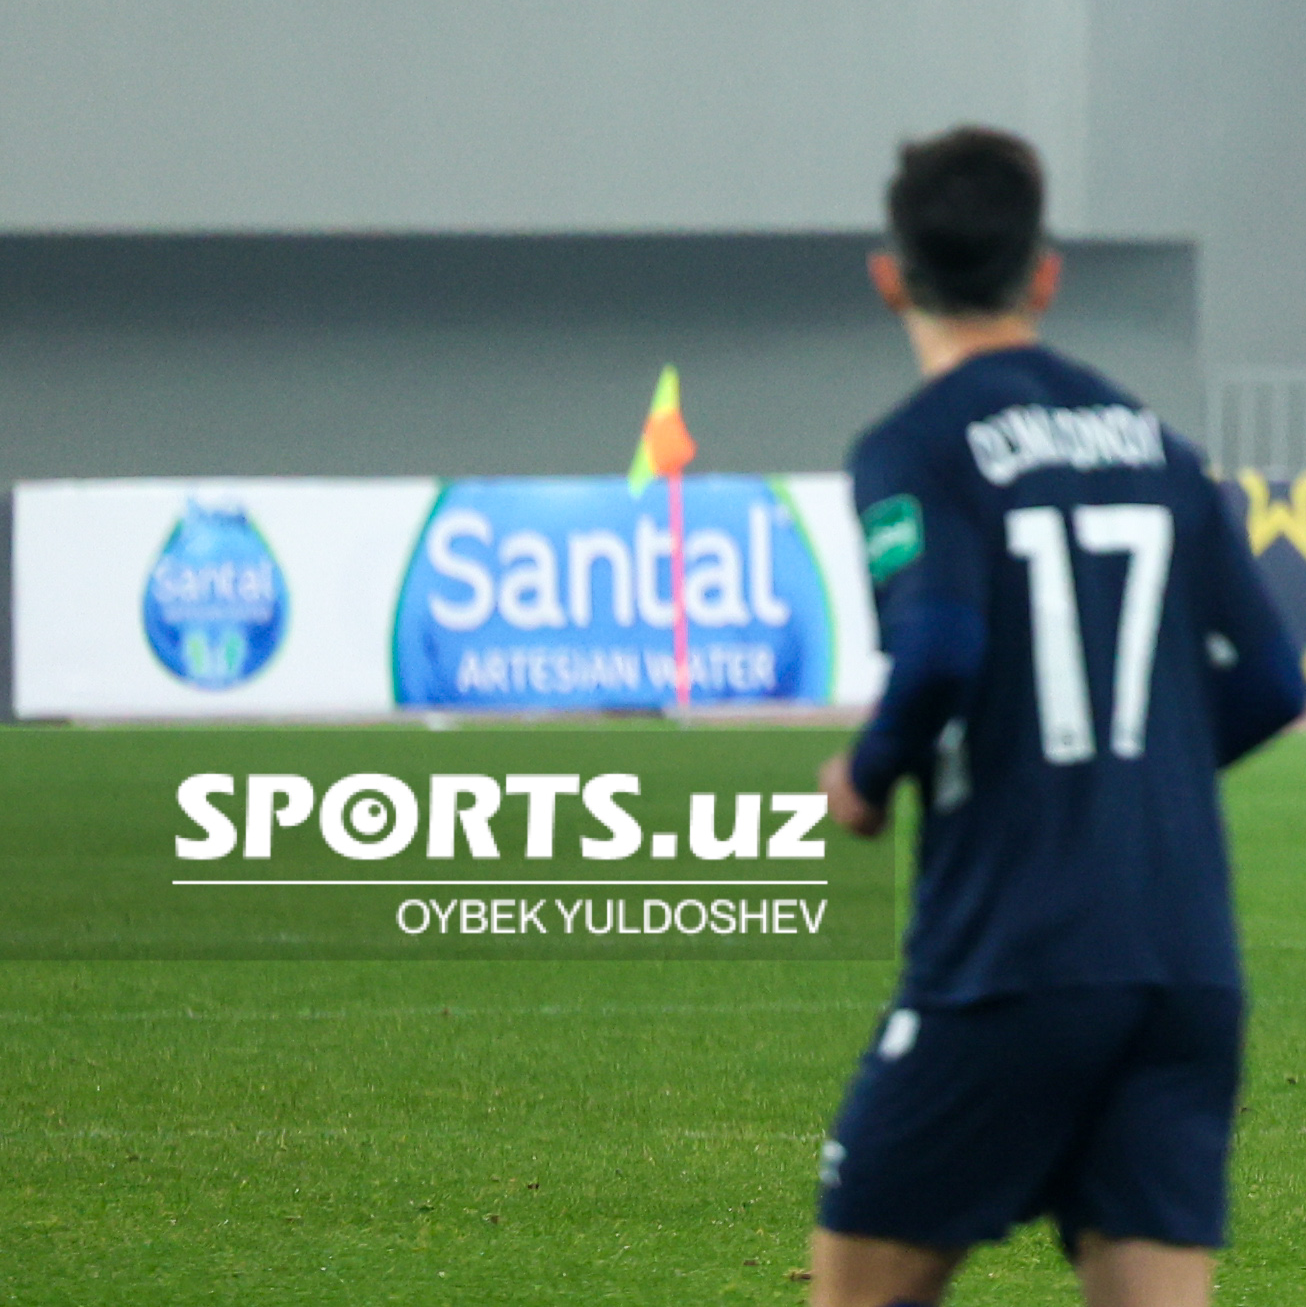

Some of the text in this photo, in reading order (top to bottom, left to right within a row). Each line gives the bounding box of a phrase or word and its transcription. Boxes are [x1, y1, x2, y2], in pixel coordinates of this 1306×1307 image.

[427, 504, 792, 632] Santal
[456, 643, 776, 692] ARTESIAN WATER
[1003, 502, 1176, 767] 17
